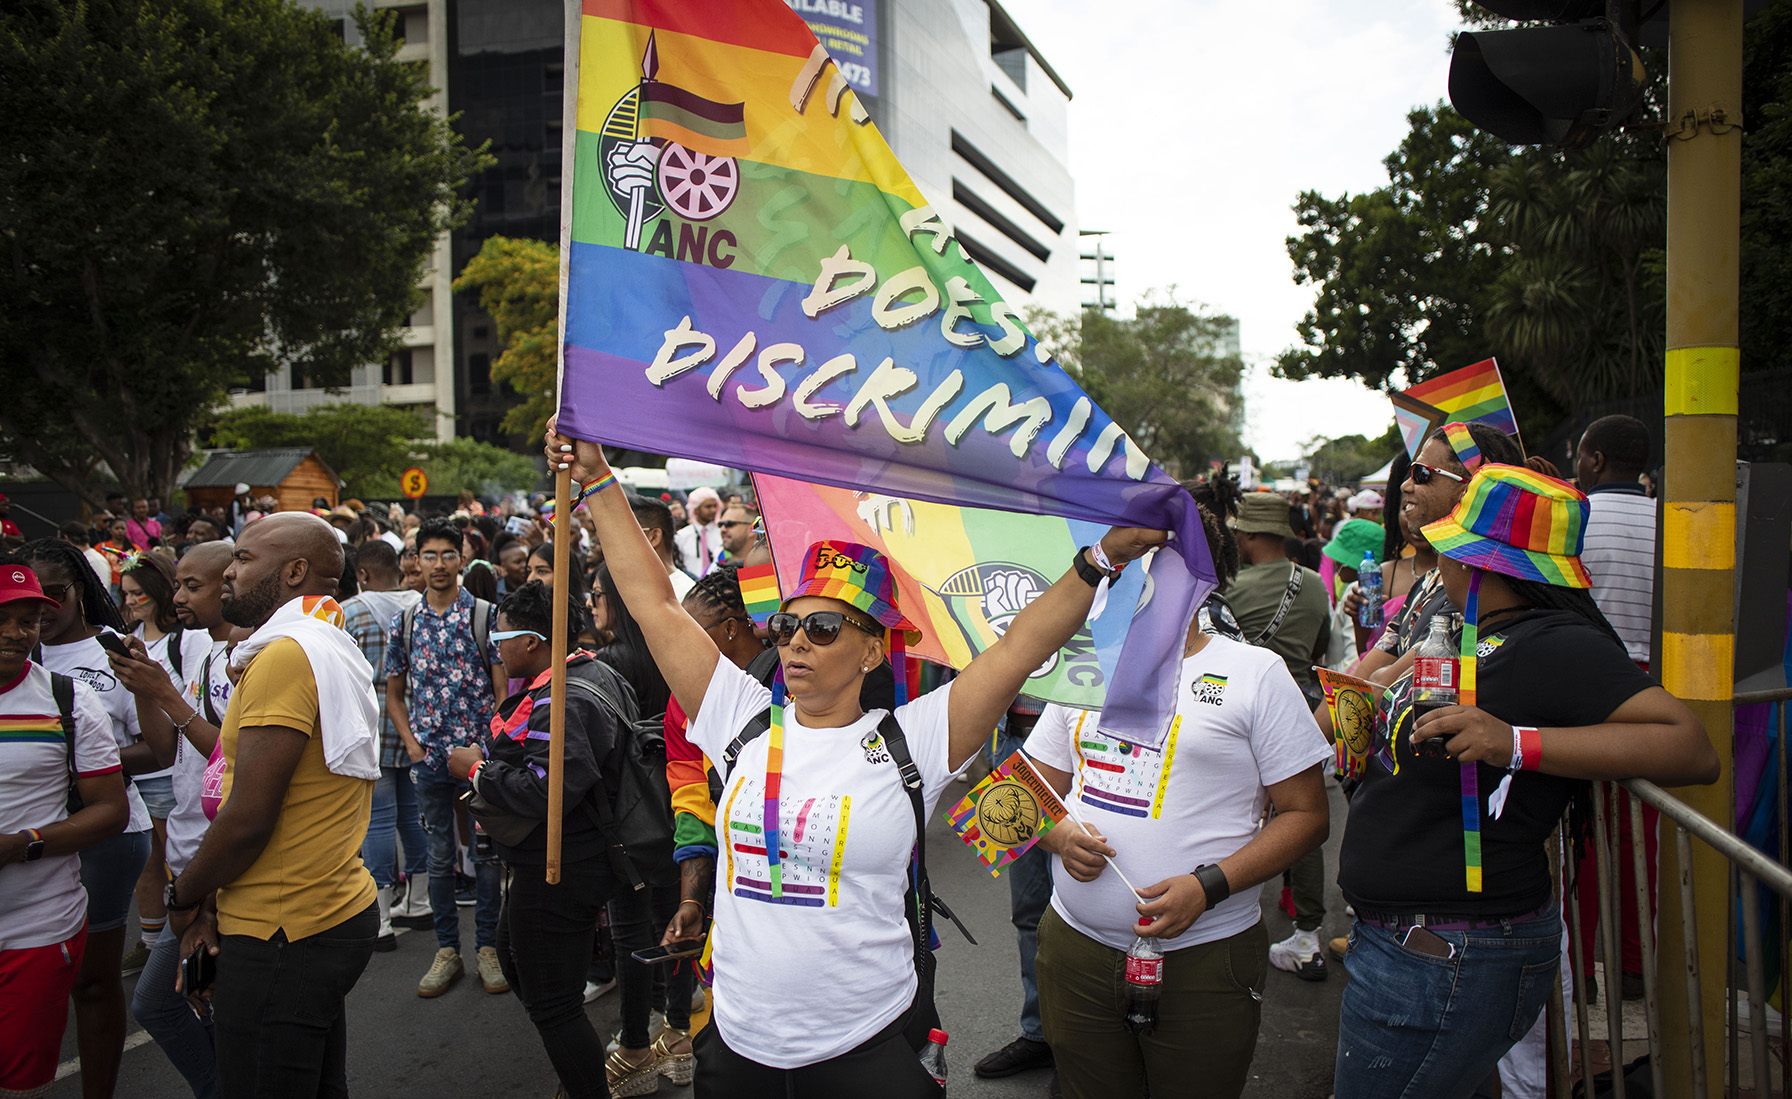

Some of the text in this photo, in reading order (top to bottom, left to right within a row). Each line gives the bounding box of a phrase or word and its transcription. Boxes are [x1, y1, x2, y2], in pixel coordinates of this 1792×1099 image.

[644, 218, 738, 270] ANC
[803, 244, 1027, 357] DOES
[1275, 596, 1292, 622] JEANS
[1200, 695, 1223, 706] ANC
[1083, 742, 1106, 752] GAY
[867, 753, 889, 764] ANC
[1154, 715, 1181, 819] INTERSEXUAL
[733, 822, 760, 833] GAY
